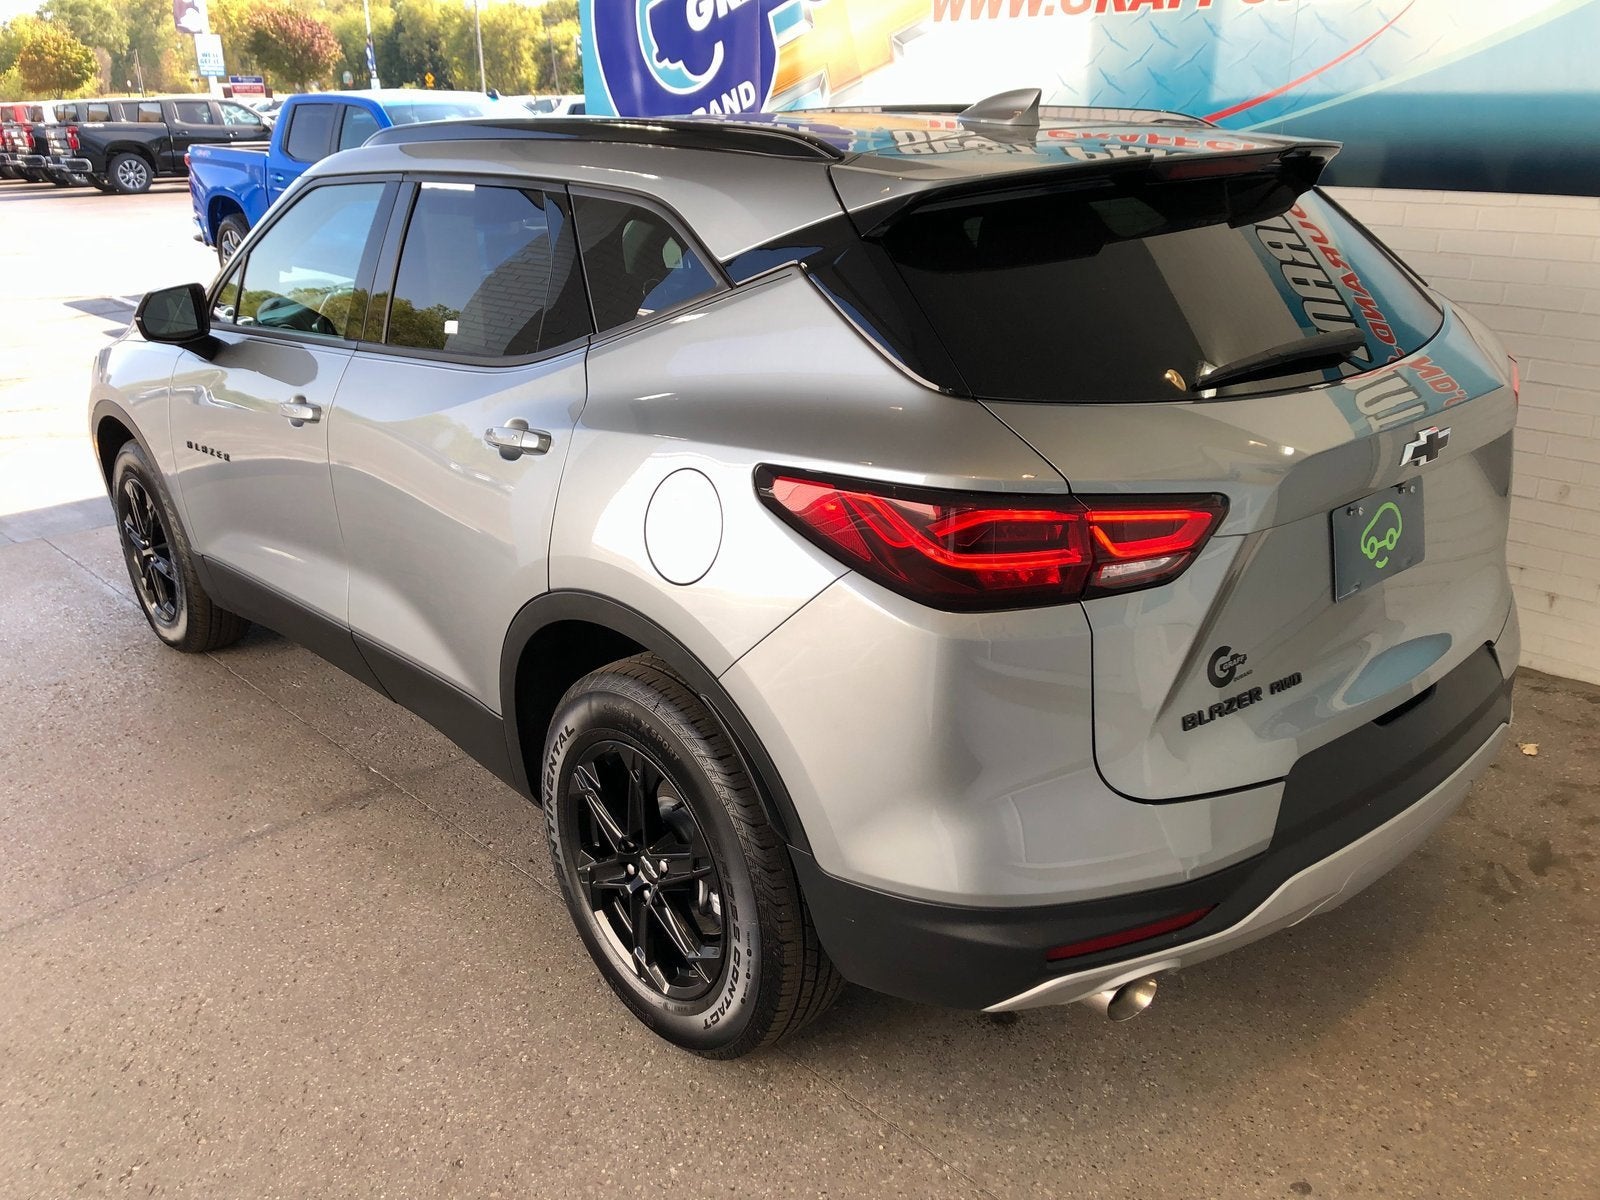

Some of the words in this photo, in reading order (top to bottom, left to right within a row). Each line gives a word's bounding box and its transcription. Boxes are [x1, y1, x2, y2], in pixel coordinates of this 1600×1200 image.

[186, 440, 231, 463] BLAZER
[1182, 686, 1263, 732] BLAZER
[1269, 671, 1303, 695] AWD
